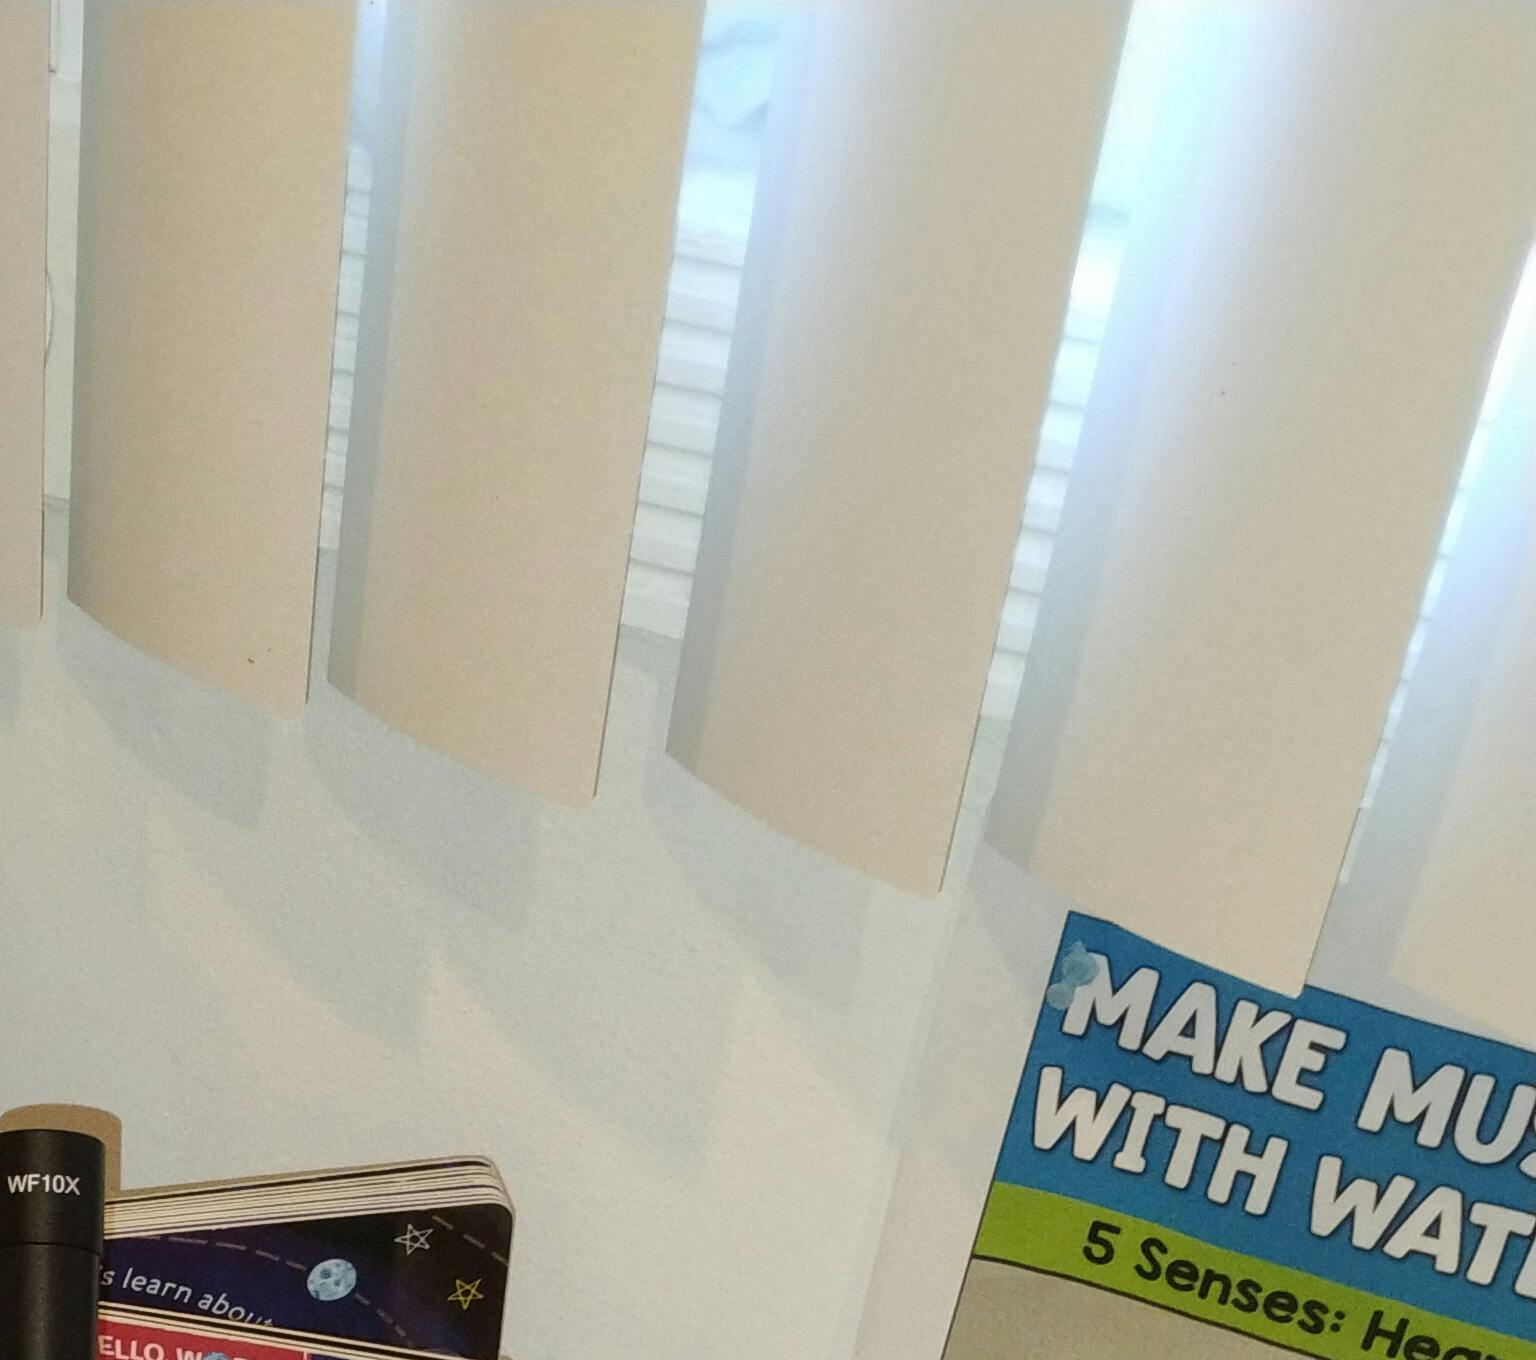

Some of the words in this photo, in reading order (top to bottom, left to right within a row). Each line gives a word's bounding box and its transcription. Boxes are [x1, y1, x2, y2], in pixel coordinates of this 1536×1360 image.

[1060, 951, 1349, 1112] MAKE
[1357, 1047, 1536, 1179] MU
[7, 1173, 81, 1196] WF10X
[1032, 1065, 1290, 1216] WITH
[122, 1266, 192, 1304] learn
[1082, 1220, 1123, 1266] 5
[1134, 1236, 1347, 1335] Senses:
